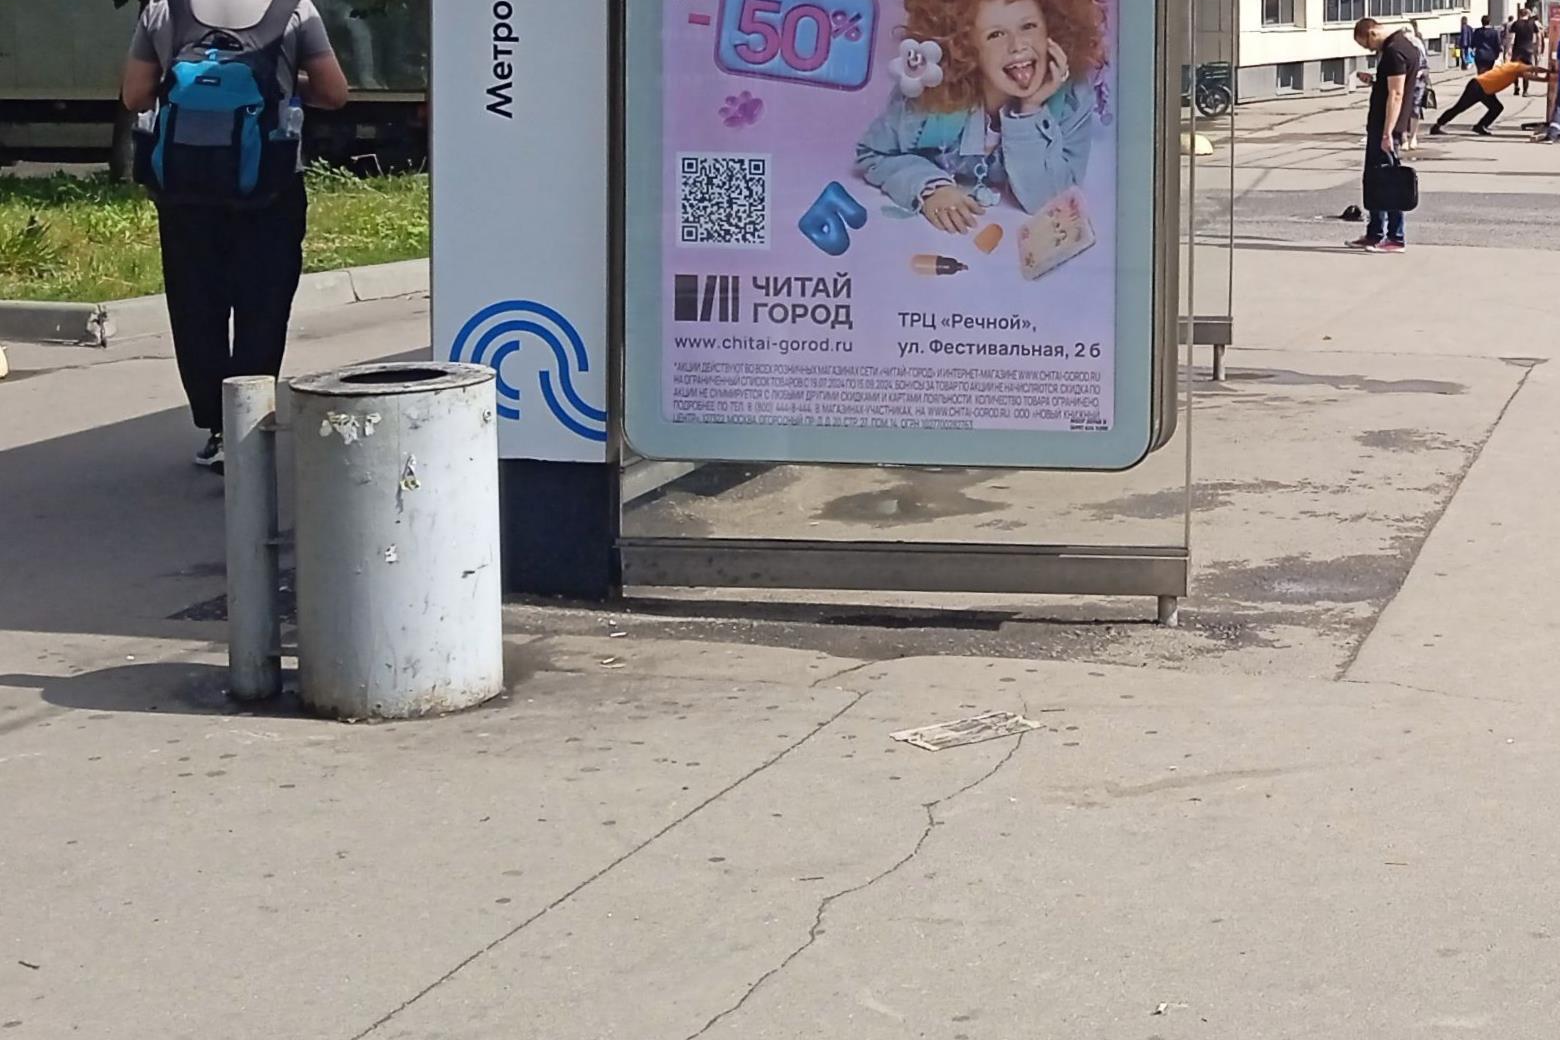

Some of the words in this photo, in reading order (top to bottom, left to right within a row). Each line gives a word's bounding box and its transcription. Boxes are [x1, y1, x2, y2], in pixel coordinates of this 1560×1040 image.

[486, 0, 519, 118] Метро
[752, 272, 852, 299] ЧИТАЙ
[753, 303, 853, 329] ГОРОД
[898, 312, 936, 330] ТРЦ
[941, 314, 1037, 332] «Речной»,
[675, 336, 853, 355] www.chitai-gorod.ru
[897, 342, 924, 357] ул.
[929, 340, 1069, 359] Фестивальная,
[1074, 342, 1086, 358] 2
